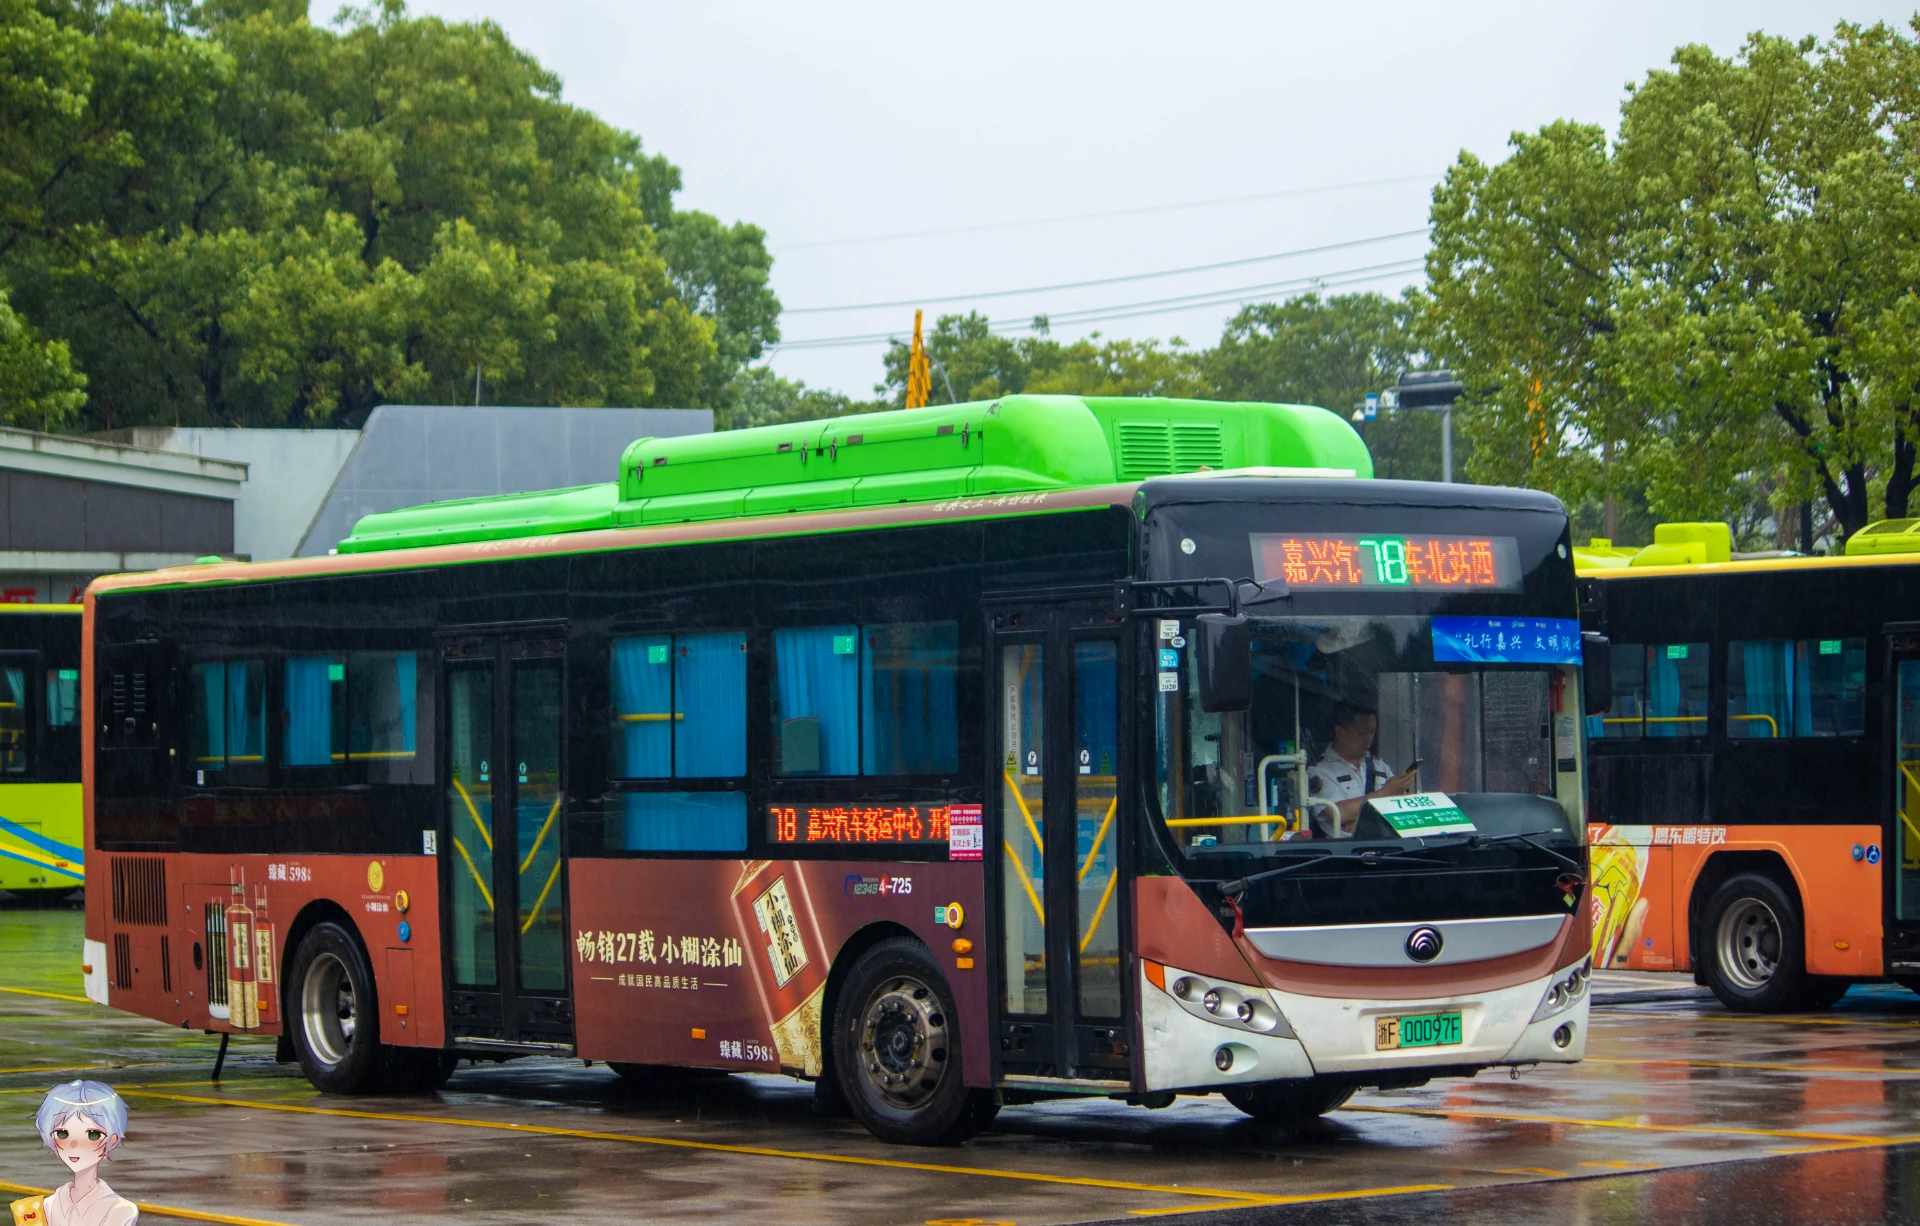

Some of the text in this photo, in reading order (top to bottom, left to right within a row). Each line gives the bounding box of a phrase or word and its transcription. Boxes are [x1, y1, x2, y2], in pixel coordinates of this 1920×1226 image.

[1359, 540, 1408, 583] 78
[1390, 796, 1436, 809] 78路
[770, 807, 797, 842] 78
[807, 806, 923, 842] 嘉兴汽车客运中心
[1588, 827, 1727, 844] 了 喝东鹏特饮
[289, 866, 307, 882] 598
[853, 883, 879, 895] 12345
[766, 892, 799, 976] 小糊涂仙
[576, 929, 657, 965] 畅销27载
[660, 935, 743, 968] 小糊涂仙
[618, 973, 698, 990] 成就国民高品质生活
[1378, 1017, 1460, 1045] 浙F 00097F
[746, 1045, 768, 1061] 598
